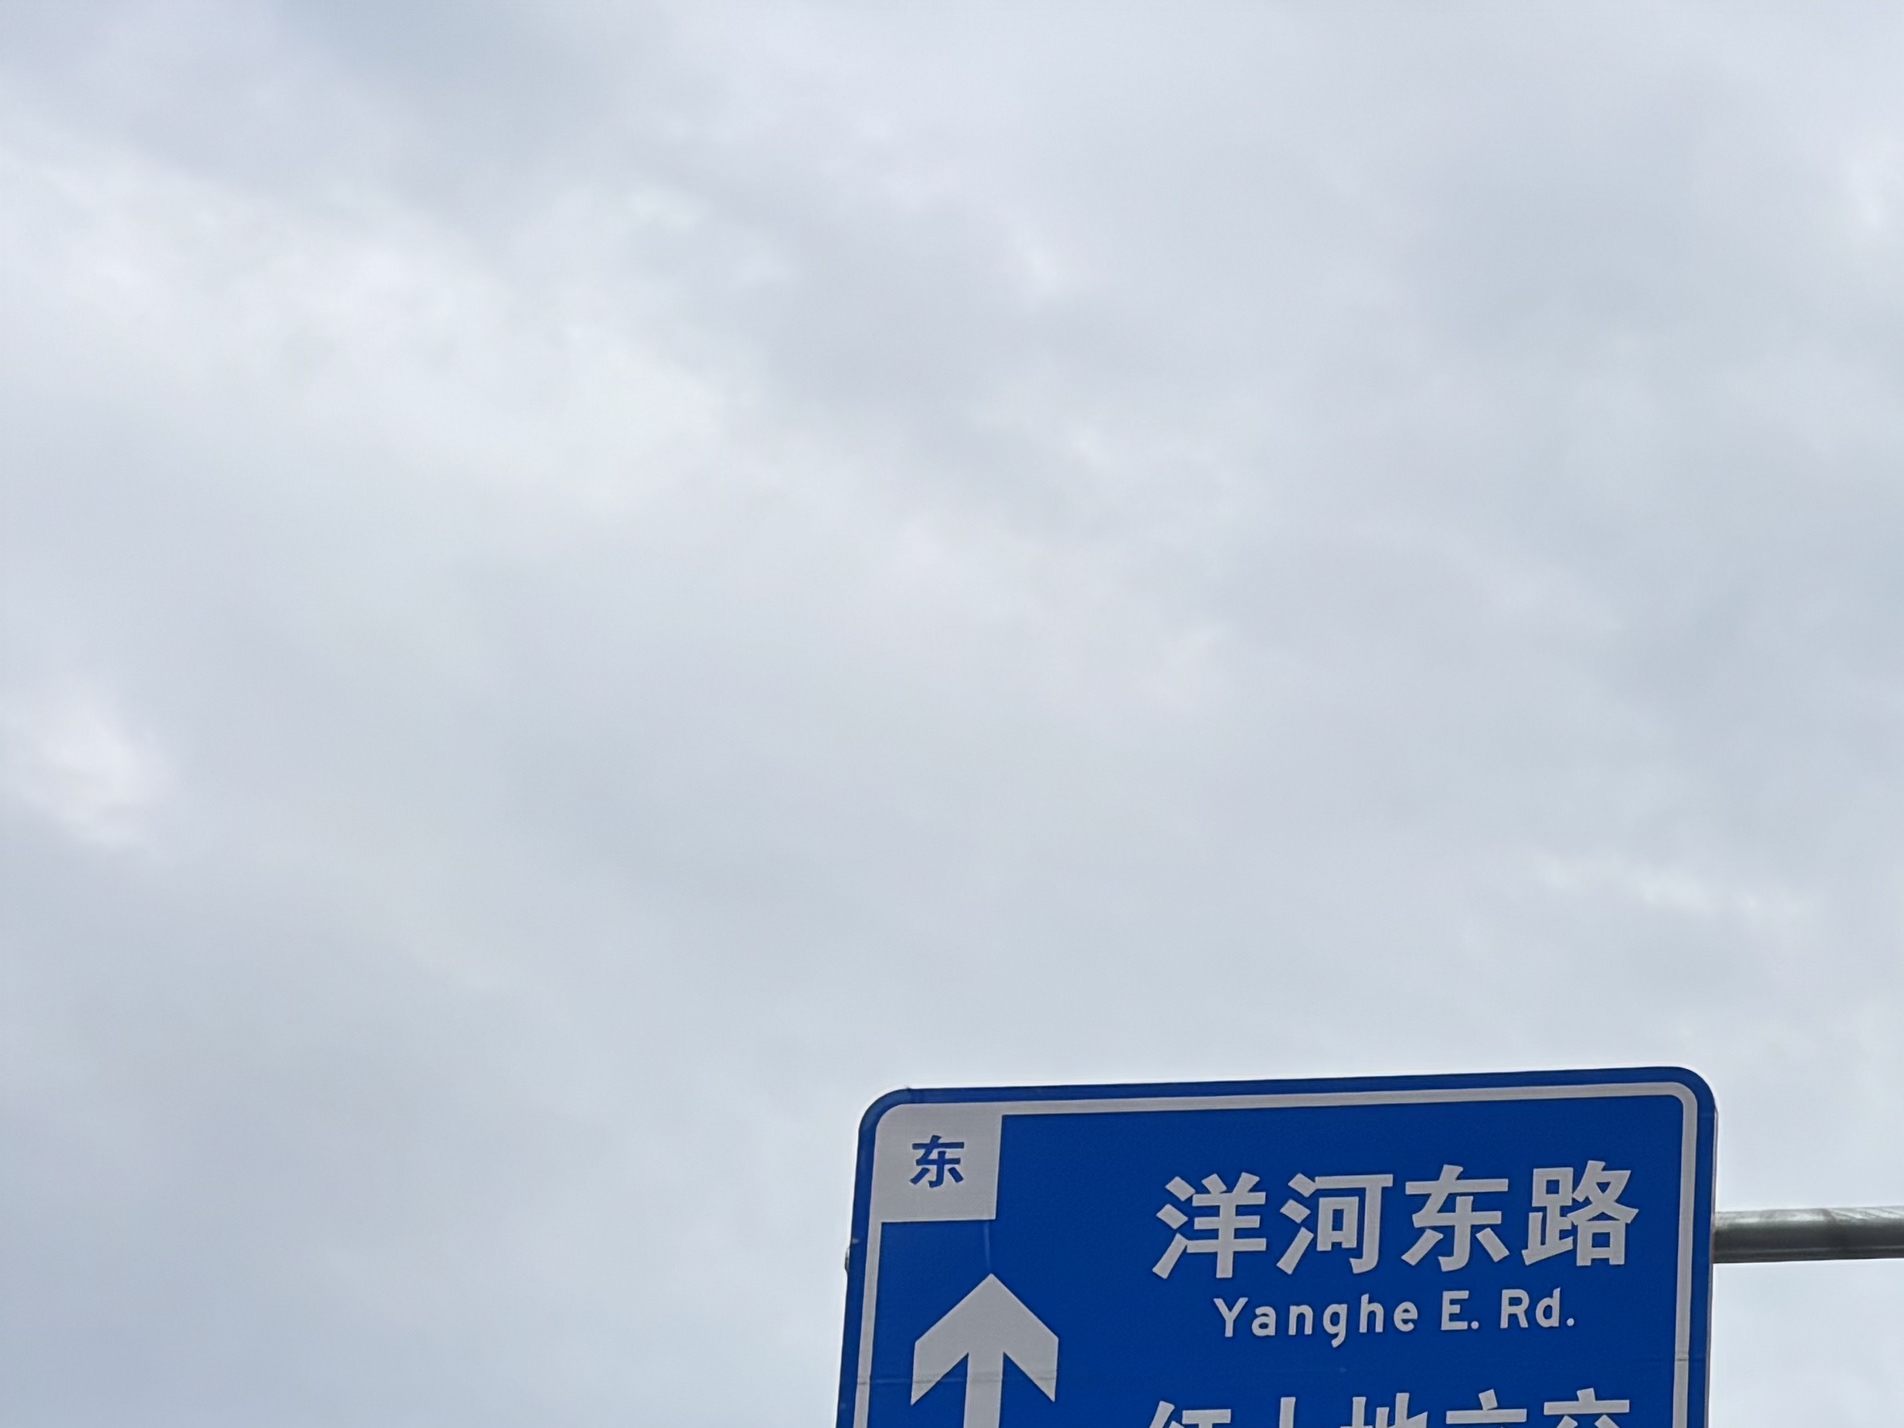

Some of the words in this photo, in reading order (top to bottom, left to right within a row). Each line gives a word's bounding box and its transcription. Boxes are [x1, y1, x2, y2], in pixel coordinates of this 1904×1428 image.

[908, 1133, 966, 1190] 东
[1151, 1158, 1640, 1279] 洋河东路
[1212, 1297, 1419, 1347] Yanghe
[1440, 1290, 1481, 1331] E.
[1500, 1286, 1576, 1329] Rd.
